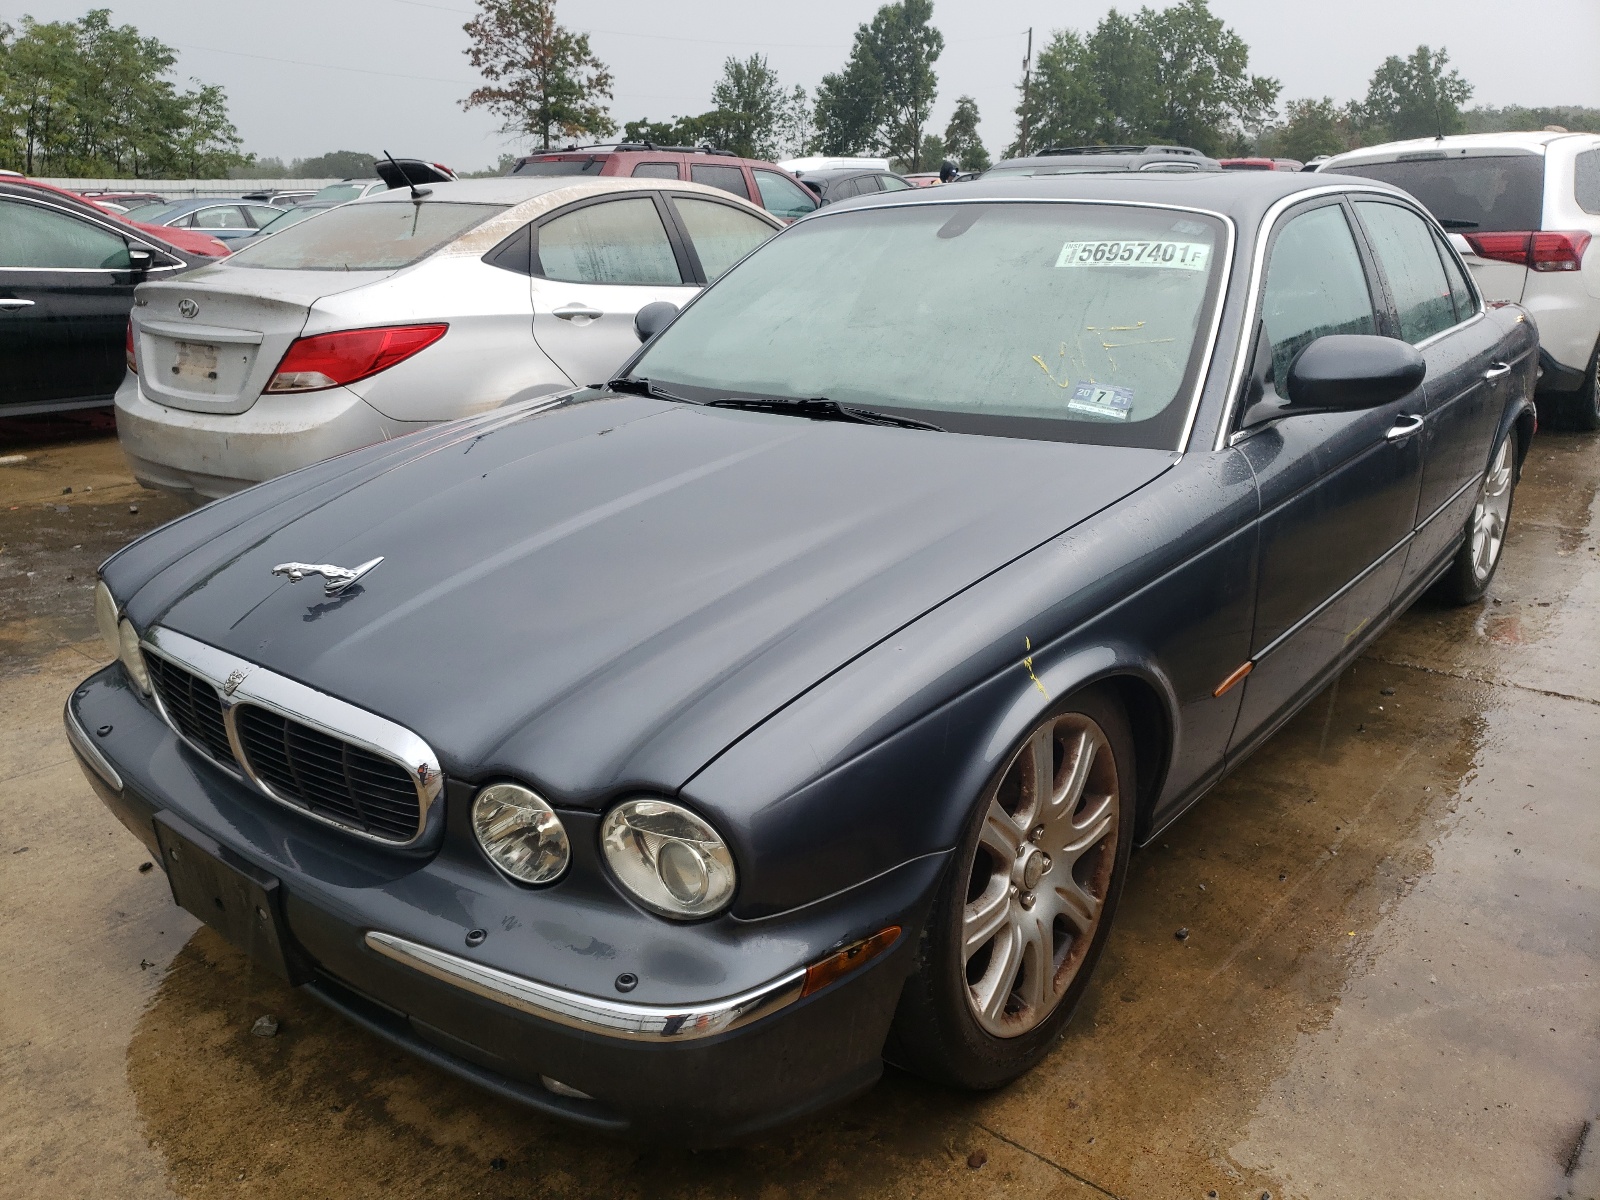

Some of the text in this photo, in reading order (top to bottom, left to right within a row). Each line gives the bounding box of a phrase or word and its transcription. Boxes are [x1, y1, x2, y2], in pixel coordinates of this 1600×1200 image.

[1078, 243, 1190, 263] 56957401
[1076, 388, 1091, 397] 20
[1096, 391, 1107, 402] 7
